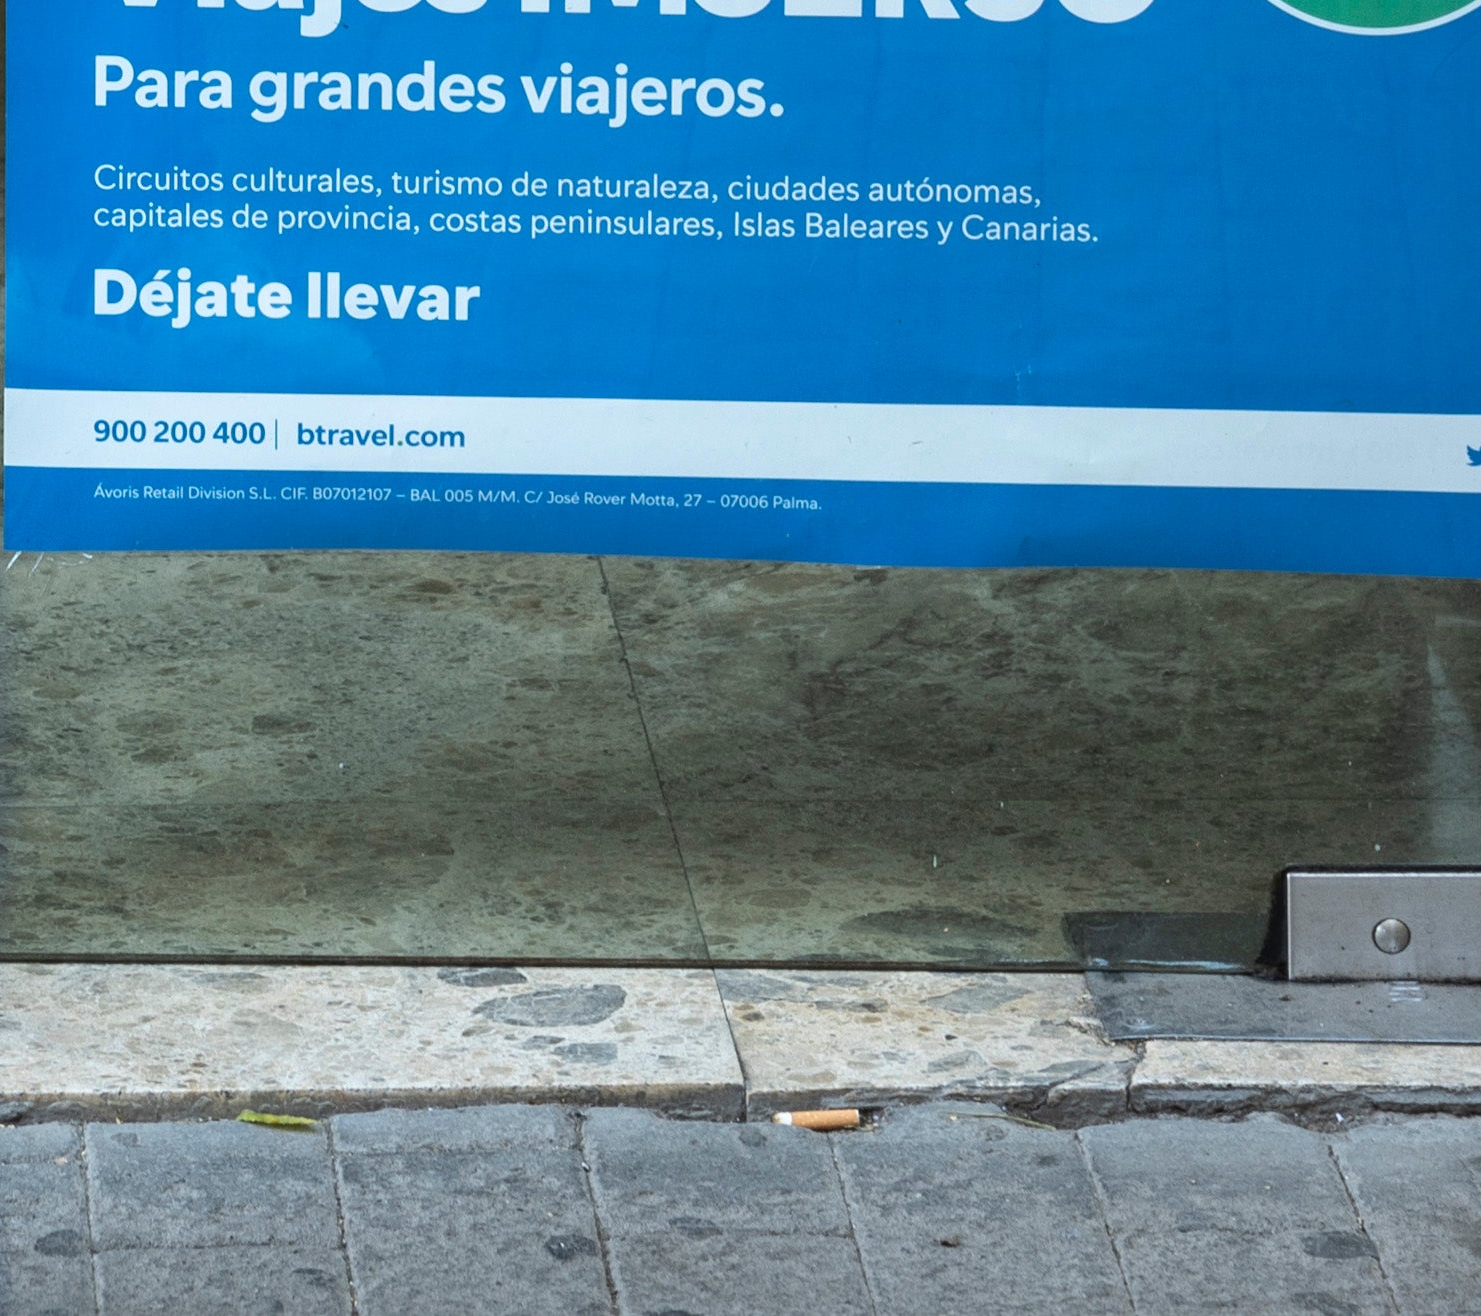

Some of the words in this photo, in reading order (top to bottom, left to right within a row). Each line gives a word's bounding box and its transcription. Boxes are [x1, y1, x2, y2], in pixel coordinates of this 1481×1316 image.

[95, 55, 232, 109] Para
[250, 60, 505, 122] grandes
[521, 62, 783, 127] viajeros.
[95, 165, 223, 191] Circuitos
[233, 167, 381, 197] culturales,
[392, 170, 502, 196] turismo
[512, 171, 547, 196] de
[558, 174, 717, 203] naturaleza,
[728, 175, 859, 201] ciudades
[869, 177, 1040, 207] autónomas,
[94, 202, 223, 232] capitales
[232, 204, 268, 228] de
[279, 205, 419, 234] provincia,
[430, 211, 521, 233] costas
[532, 209, 722, 240] peninsulares,
[735, 212, 795, 237] Islas
[806, 213, 928, 238] Baleares
[937, 221, 953, 245] y
[962, 214, 1098, 242] Canarias.
[95, 268, 292, 328] Déjate
[308, 272, 480, 320] llevar
[94, 420, 146, 442] 900
[154, 421, 205, 443] 200
[213, 422, 265, 444] 400
[298, 423, 464, 447] btravel.com
[94, 483, 139, 498] Ávoris
[144, 486, 183, 498] Retail
[189, 486, 244, 499] Division
[248, 487, 277, 500] S.L.
[280, 487, 308, 500] CIF.
[313, 487, 391, 500] B07012107
[411, 489, 440, 501] BAL
[445, 490, 473, 502] 005
[479, 490, 519, 502] M/M.
[524, 491, 542, 503] C/
[547, 491, 579, 504] José
[585, 492, 625, 505] Rover
[631, 493, 679, 507] Motta,
[684, 494, 701, 506] 27
[721, 495, 768, 508] 07006
[774, 496, 821, 509] Palma.
